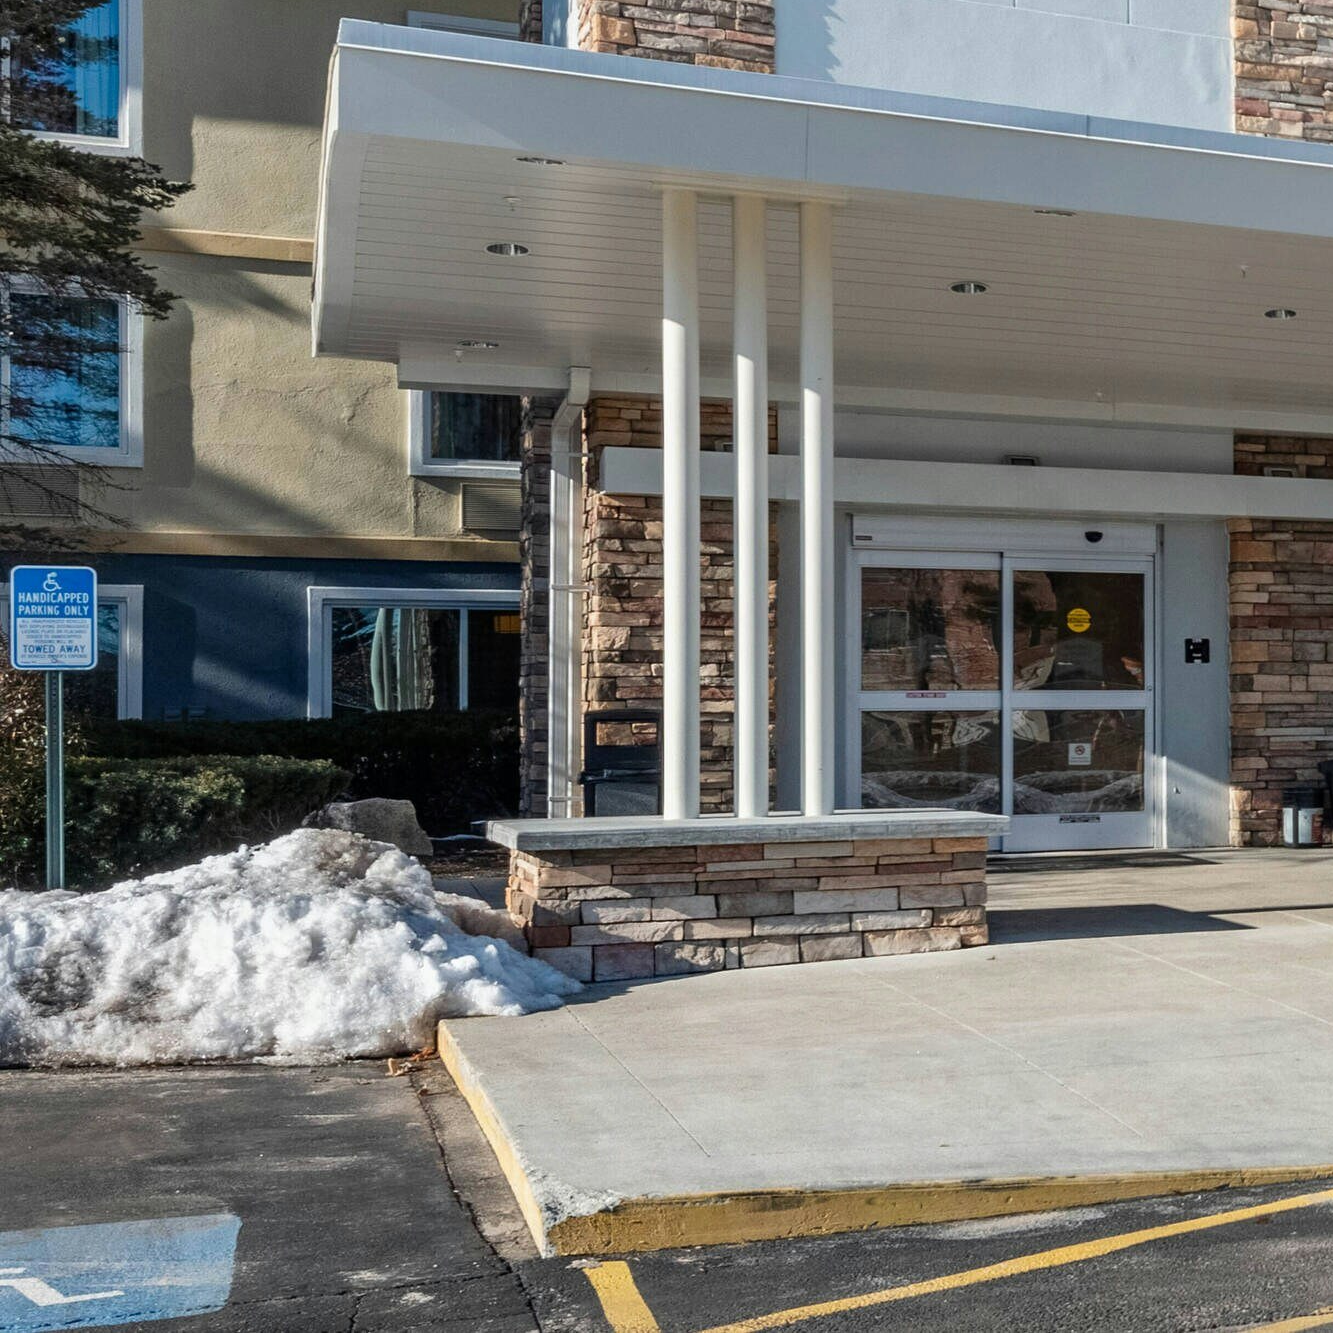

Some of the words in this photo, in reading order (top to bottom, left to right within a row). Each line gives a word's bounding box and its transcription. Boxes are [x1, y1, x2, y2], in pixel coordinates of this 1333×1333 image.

[18, 592, 89, 604] HANDICAPPED
[18, 605, 60, 616] PARKING
[64, 605, 89, 616] ONLY
[23, 644, 56, 654] TOWED
[60, 644, 86, 654] AWAY
